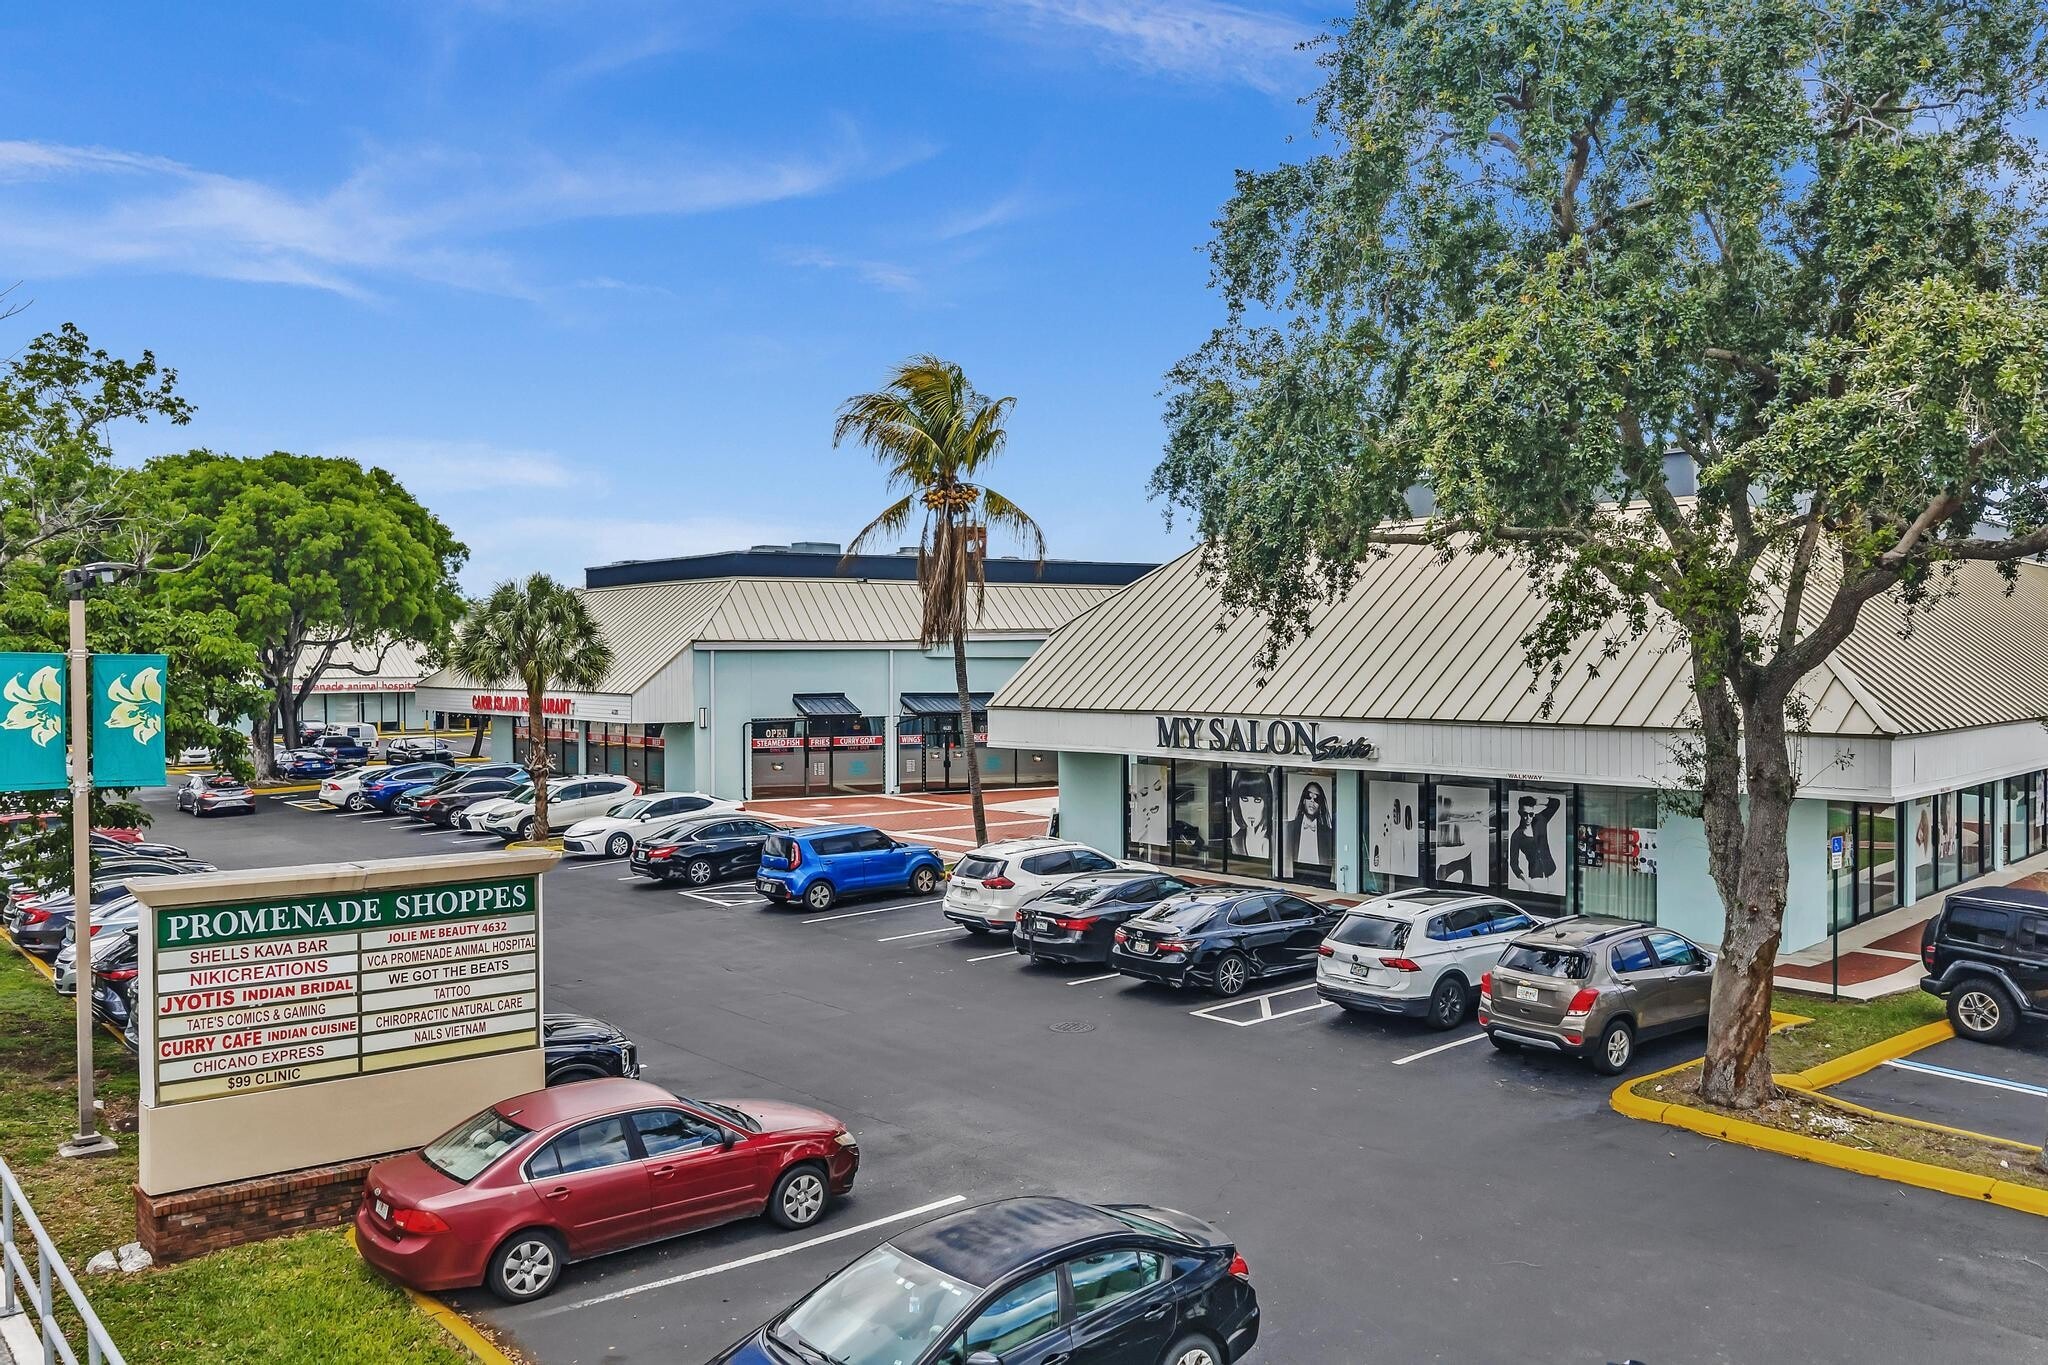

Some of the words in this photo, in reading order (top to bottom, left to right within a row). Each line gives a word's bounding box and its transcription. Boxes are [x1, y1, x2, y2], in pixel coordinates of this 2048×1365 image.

[292, 681, 344, 691] roenade
[348, 681, 379, 691] animal
[756, 738, 785, 747] STEAMED
[786, 737, 800, 746] FISH
[765, 728, 788, 738] OPEN
[810, 737, 830, 746] FRIES
[839, 737, 859, 745] CURRY
[860, 736, 876, 744] GOAT
[1155, 716, 1205, 750] MY
[1208, 717, 1320, 756] SALON
[1312, 735, 1372, 762] Suite
[167, 898, 382, 942] PROMENADE
[395, 884, 527, 919] SHOPPES
[387, 930, 417, 944] JOLIE
[419, 928, 436, 940] ME
[438, 924, 479, 938] BEAUTY
[482, 921, 507, 932] 4632
[190, 946, 250, 964] SHELLS
[254, 943, 293, 958] KAVA
[298, 939, 328, 954] BAR
[367, 954, 388, 967] VCA
[391, 947, 452, 965] PROMENADE
[454, 942, 490, 957] ANIMAL
[492, 937, 536, 952] HOSPITAL
[190, 959, 328, 986] NIKICREATIONS
[388, 972, 409, 985] WE
[412, 968, 440, 982] GOT
[443, 965, 466, 977] THE
[470, 960, 509, 975] BEATS
[160, 990, 235, 1014] JYOTIS
[242, 985, 295, 1002] INDIAN
[300, 979, 353, 995] BRIDAL
[434, 984, 471, 1000] TATTOO
[187, 1015, 224, 1032] TATE'S
[227, 1010, 270, 1026] COMICS
[273, 1008, 281, 1020] &
[283, 1003, 326, 1019] GAMING
[375, 1008, 449, 1028] CHIROPRACTIC
[451, 1002, 495, 1017] NATURAL
[497, 997, 523, 1010] CARE
[161, 1036, 216, 1057] CURRY
[222, 1031, 262, 1050] CAFE
[267, 1026, 308, 1042] INDIAN
[311, 1020, 356, 1036] CUISINE
[414, 1028, 443, 1043] NAILS
[445, 1021, 487, 1038] VIETNAM
[193, 1055, 258, 1074] CHICANO
[262, 1045, 324, 1064] EXPRESS
[227, 1075, 251, 1090] $99
[255, 1067, 301, 1085] CLINIC
